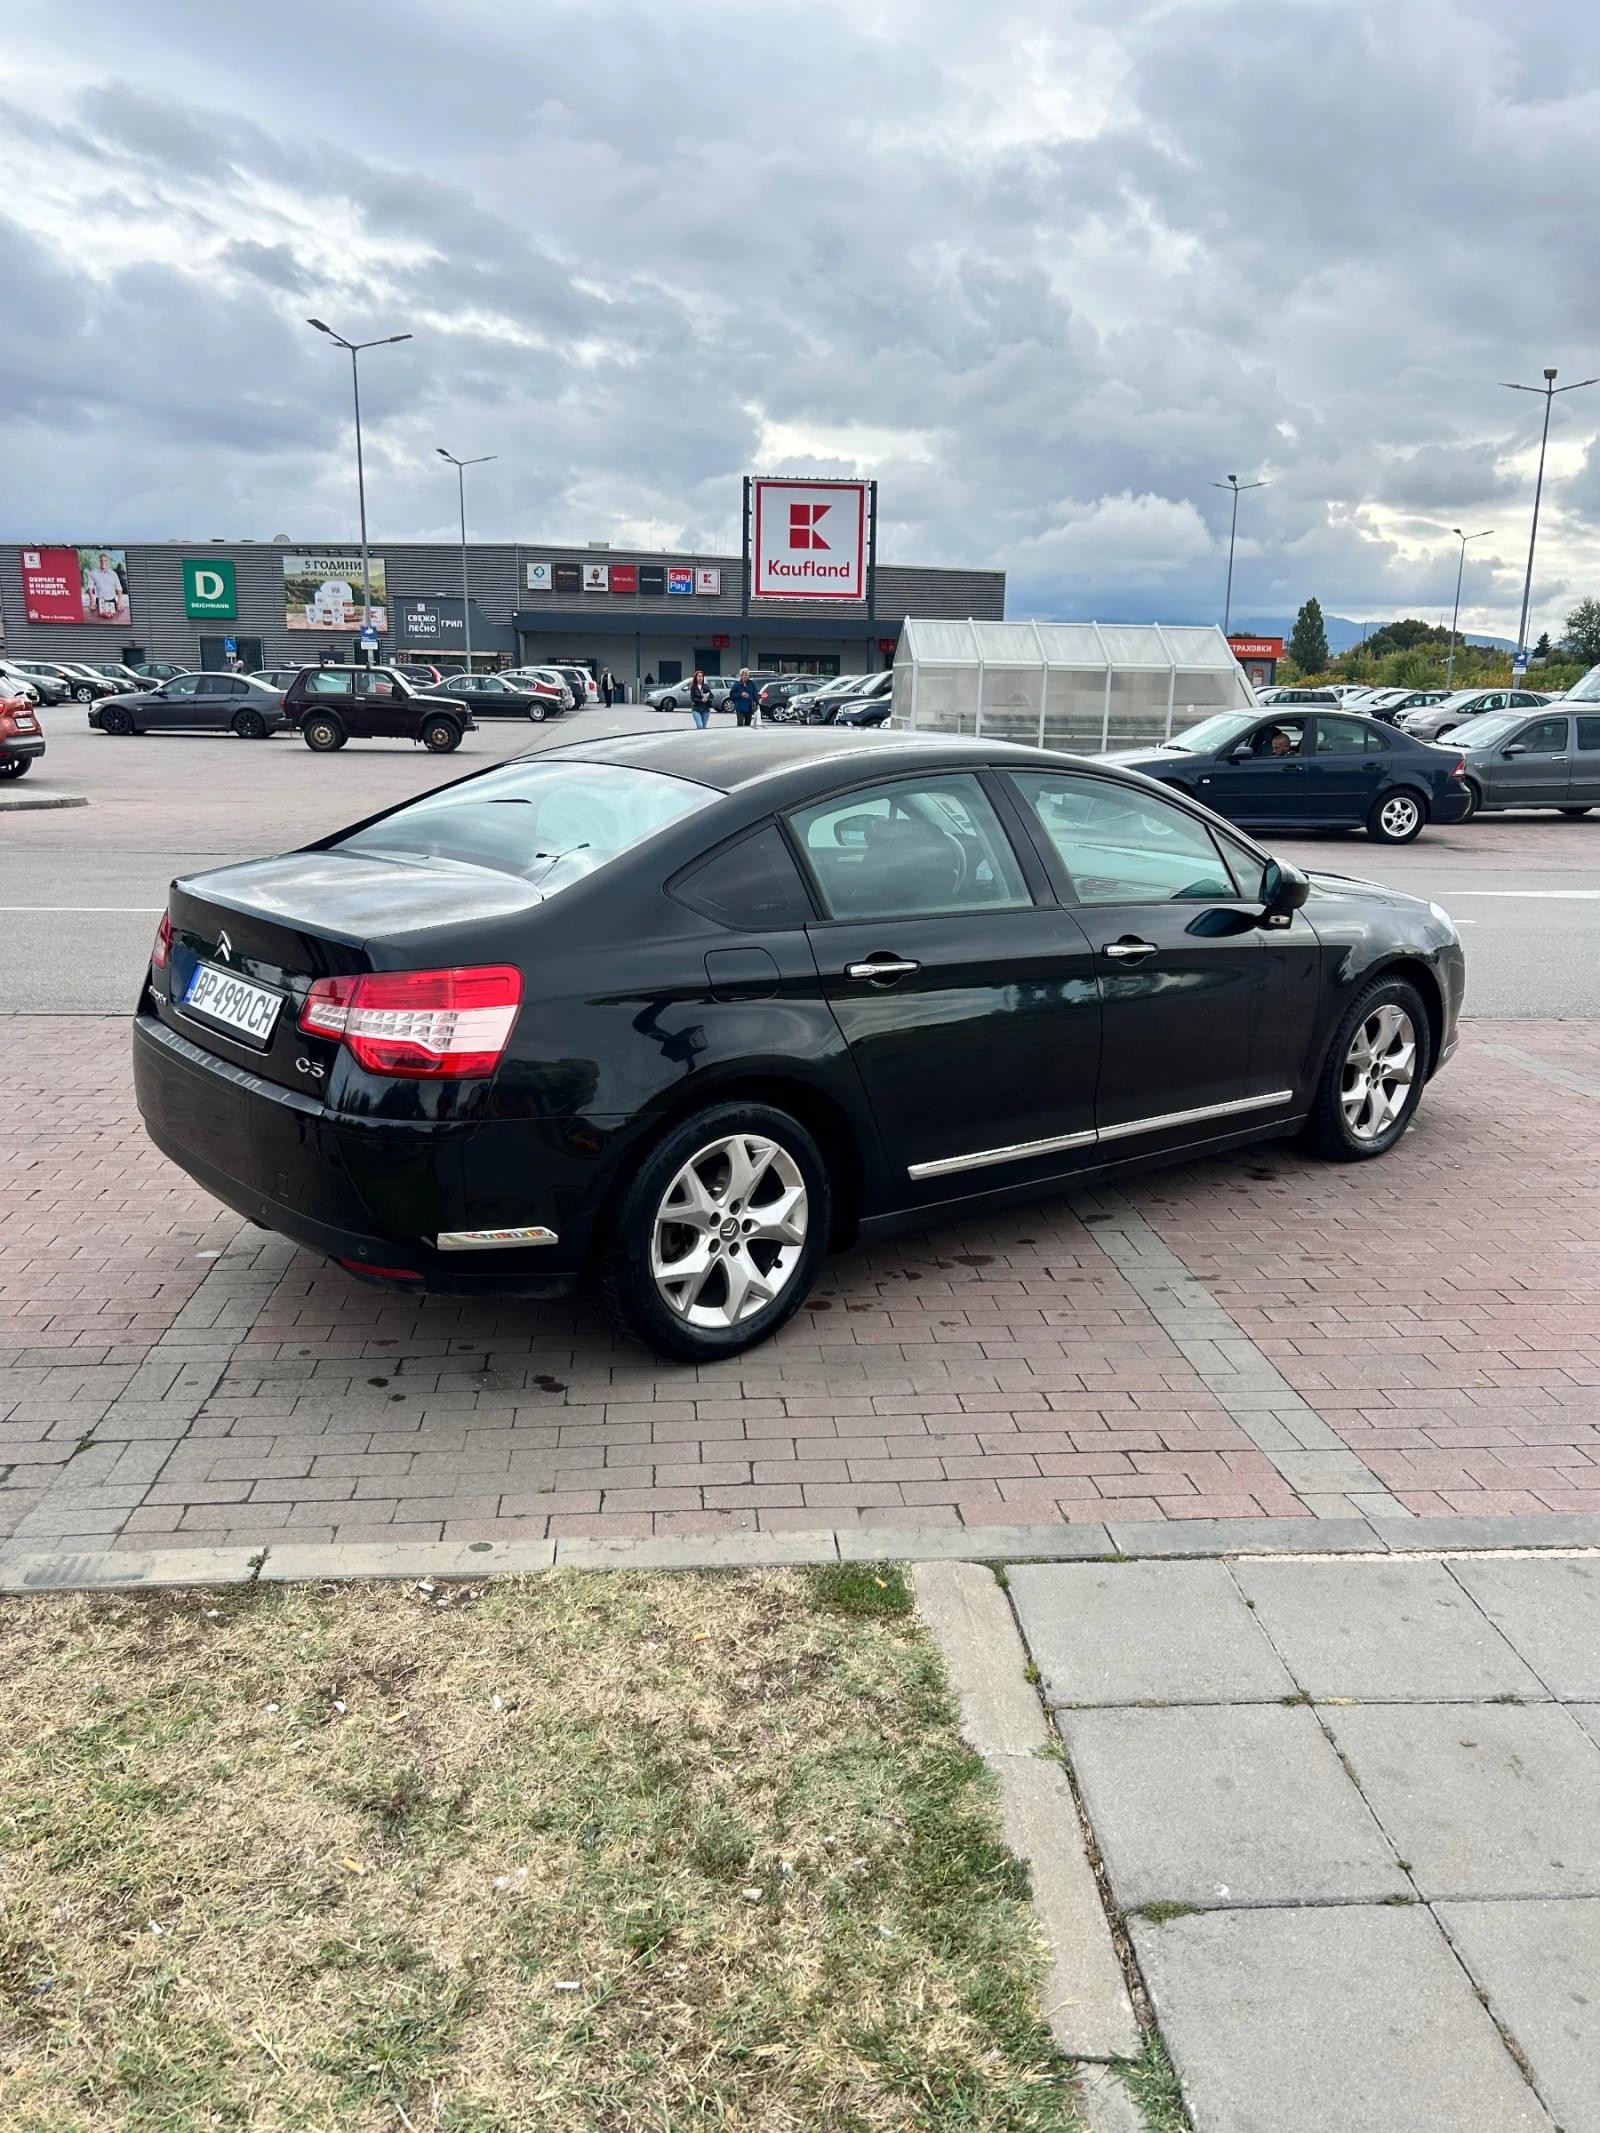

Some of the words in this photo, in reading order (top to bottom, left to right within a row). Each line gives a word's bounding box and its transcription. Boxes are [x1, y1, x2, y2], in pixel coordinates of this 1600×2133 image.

[305, 560, 311, 569] 5
[314, 560, 362, 571] ГОДИНИ
[768, 559, 850, 577] Kaufland
[669, 572, 690, 583] Easy
[670, 581, 686, 592] Pay
[407, 614, 437, 623] СВЕЖО
[440, 619, 463, 628] ГРИЛ
[408, 624, 437, 633] ЛЕСНО
[295, 1056, 325, 1078] C5
